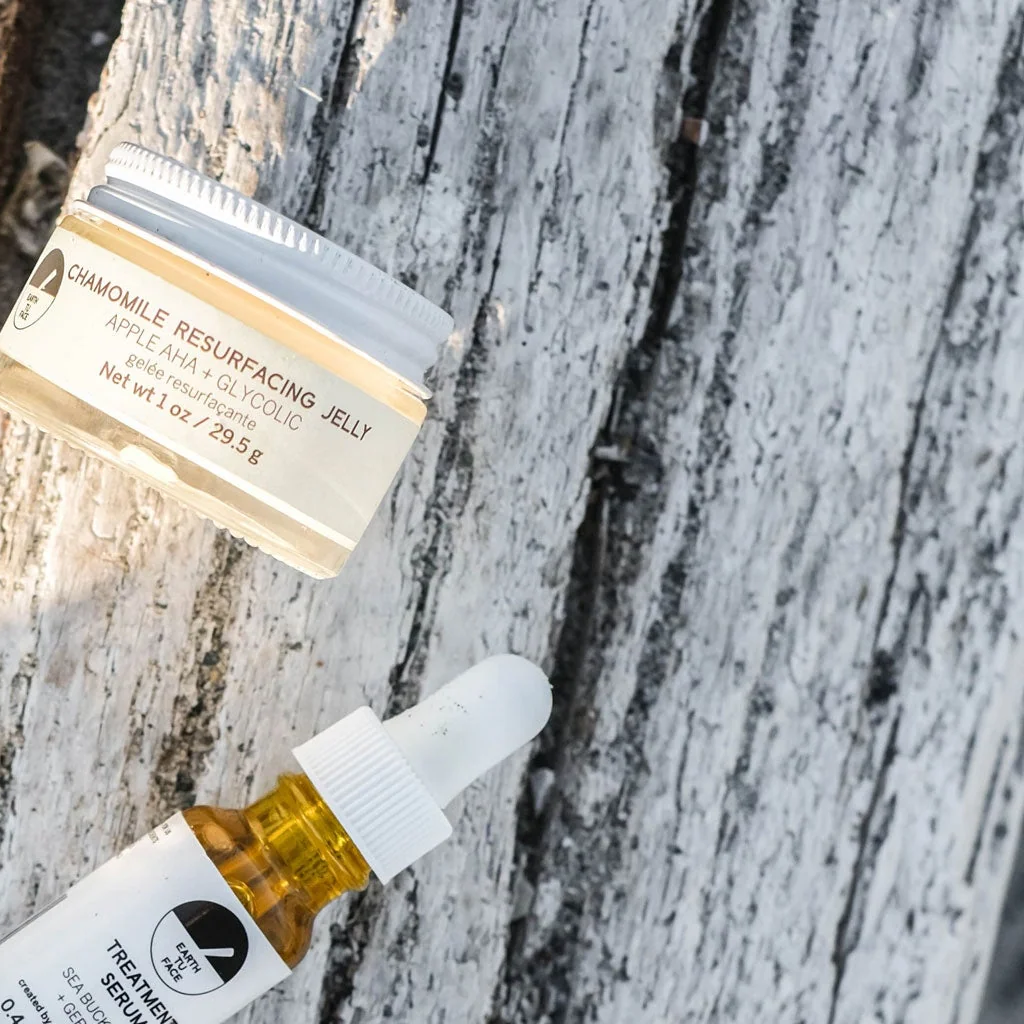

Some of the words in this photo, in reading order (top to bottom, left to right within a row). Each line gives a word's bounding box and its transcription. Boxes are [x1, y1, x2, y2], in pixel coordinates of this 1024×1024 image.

[68, 264, 170, 328] CHAMOMILE
[173, 320, 316, 409] RESURFACING
[321, 405, 372, 441] JELLY
[105, 314, 160, 352] APPLE
[159, 344, 198, 374] AHA
[202, 369, 212, 379] +
[217, 374, 303, 430] GLYCOLIC
[99, 361, 131, 389] Net
[133, 382, 156, 402] wt
[156, 393, 167, 410] 1
[170, 404, 192, 423] oz
[208, 422, 251, 453] 29.5
[248, 449, 263, 465] g
[125, 354, 165, 380] gelée
[166, 375, 256, 431] resurfaçante
[161, 957, 183, 983] FACE
[174, 956, 187, 971] TU
[176, 942, 201, 973] EARTH
[18, 979, 44, 1012] created
[41, 1010, 52, 1024] by
[62, 967, 84, 994] SEA
